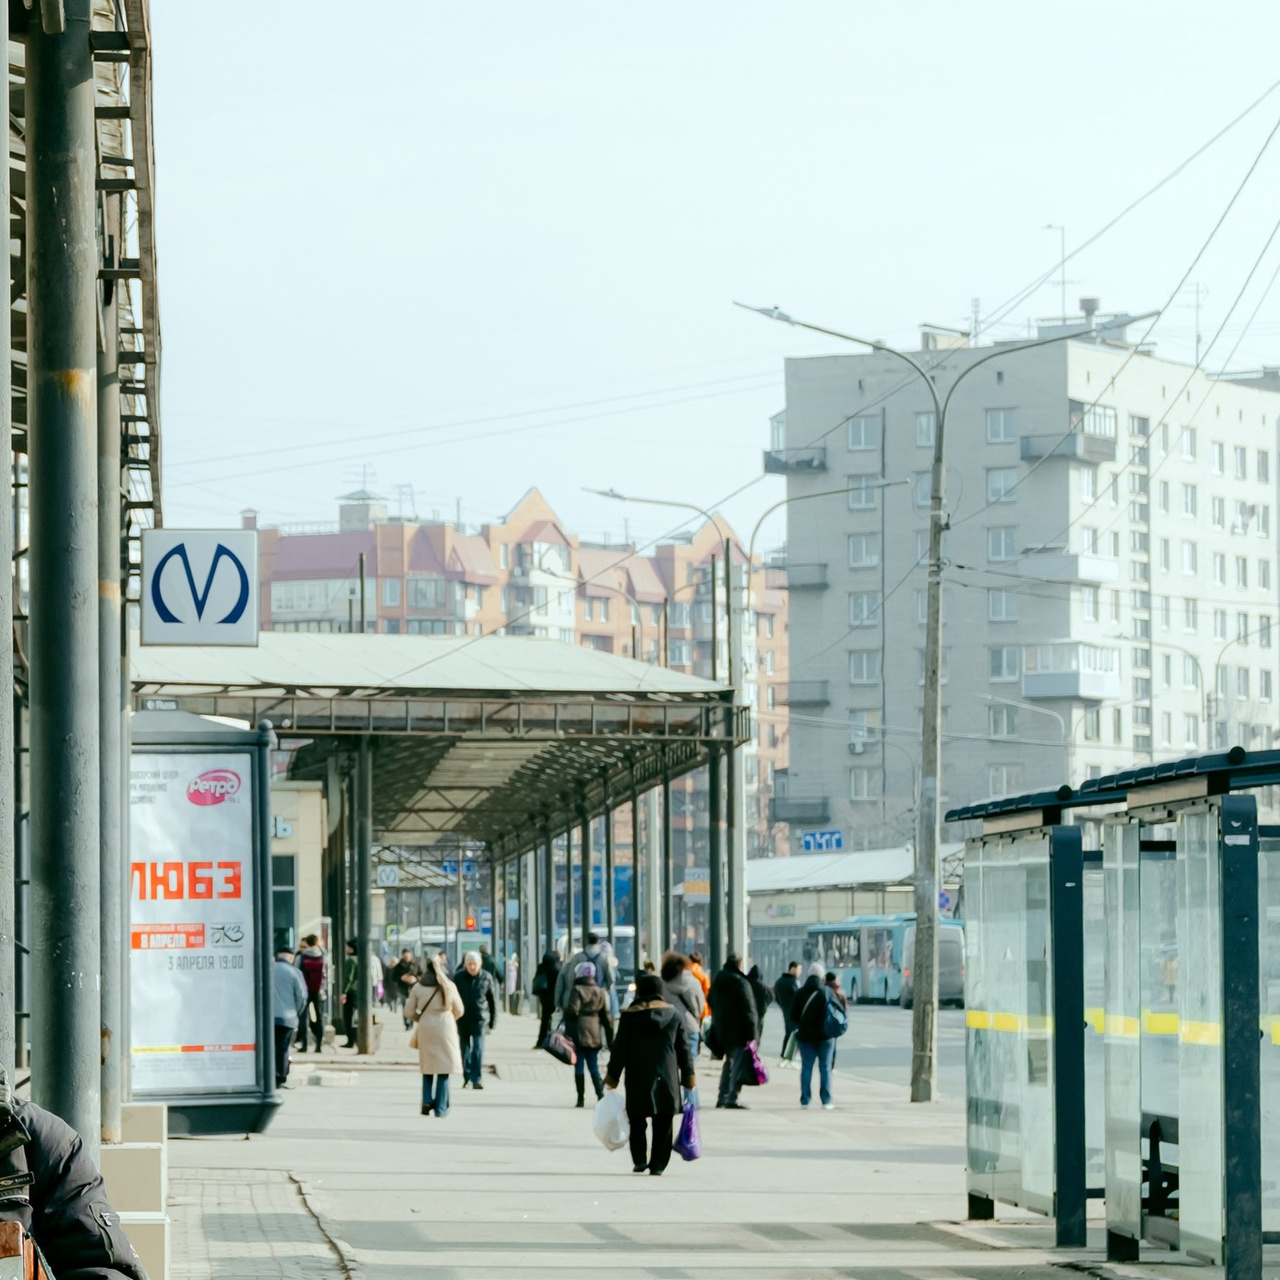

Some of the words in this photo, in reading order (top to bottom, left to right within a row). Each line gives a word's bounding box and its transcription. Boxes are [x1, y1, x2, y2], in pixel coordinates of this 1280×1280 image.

[189, 777, 241, 798] Ретро
[168, 957, 174, 970] 3
[176, 956, 214, 970] АПРЕЛЯ
[219, 955, 244, 970] 19:00
